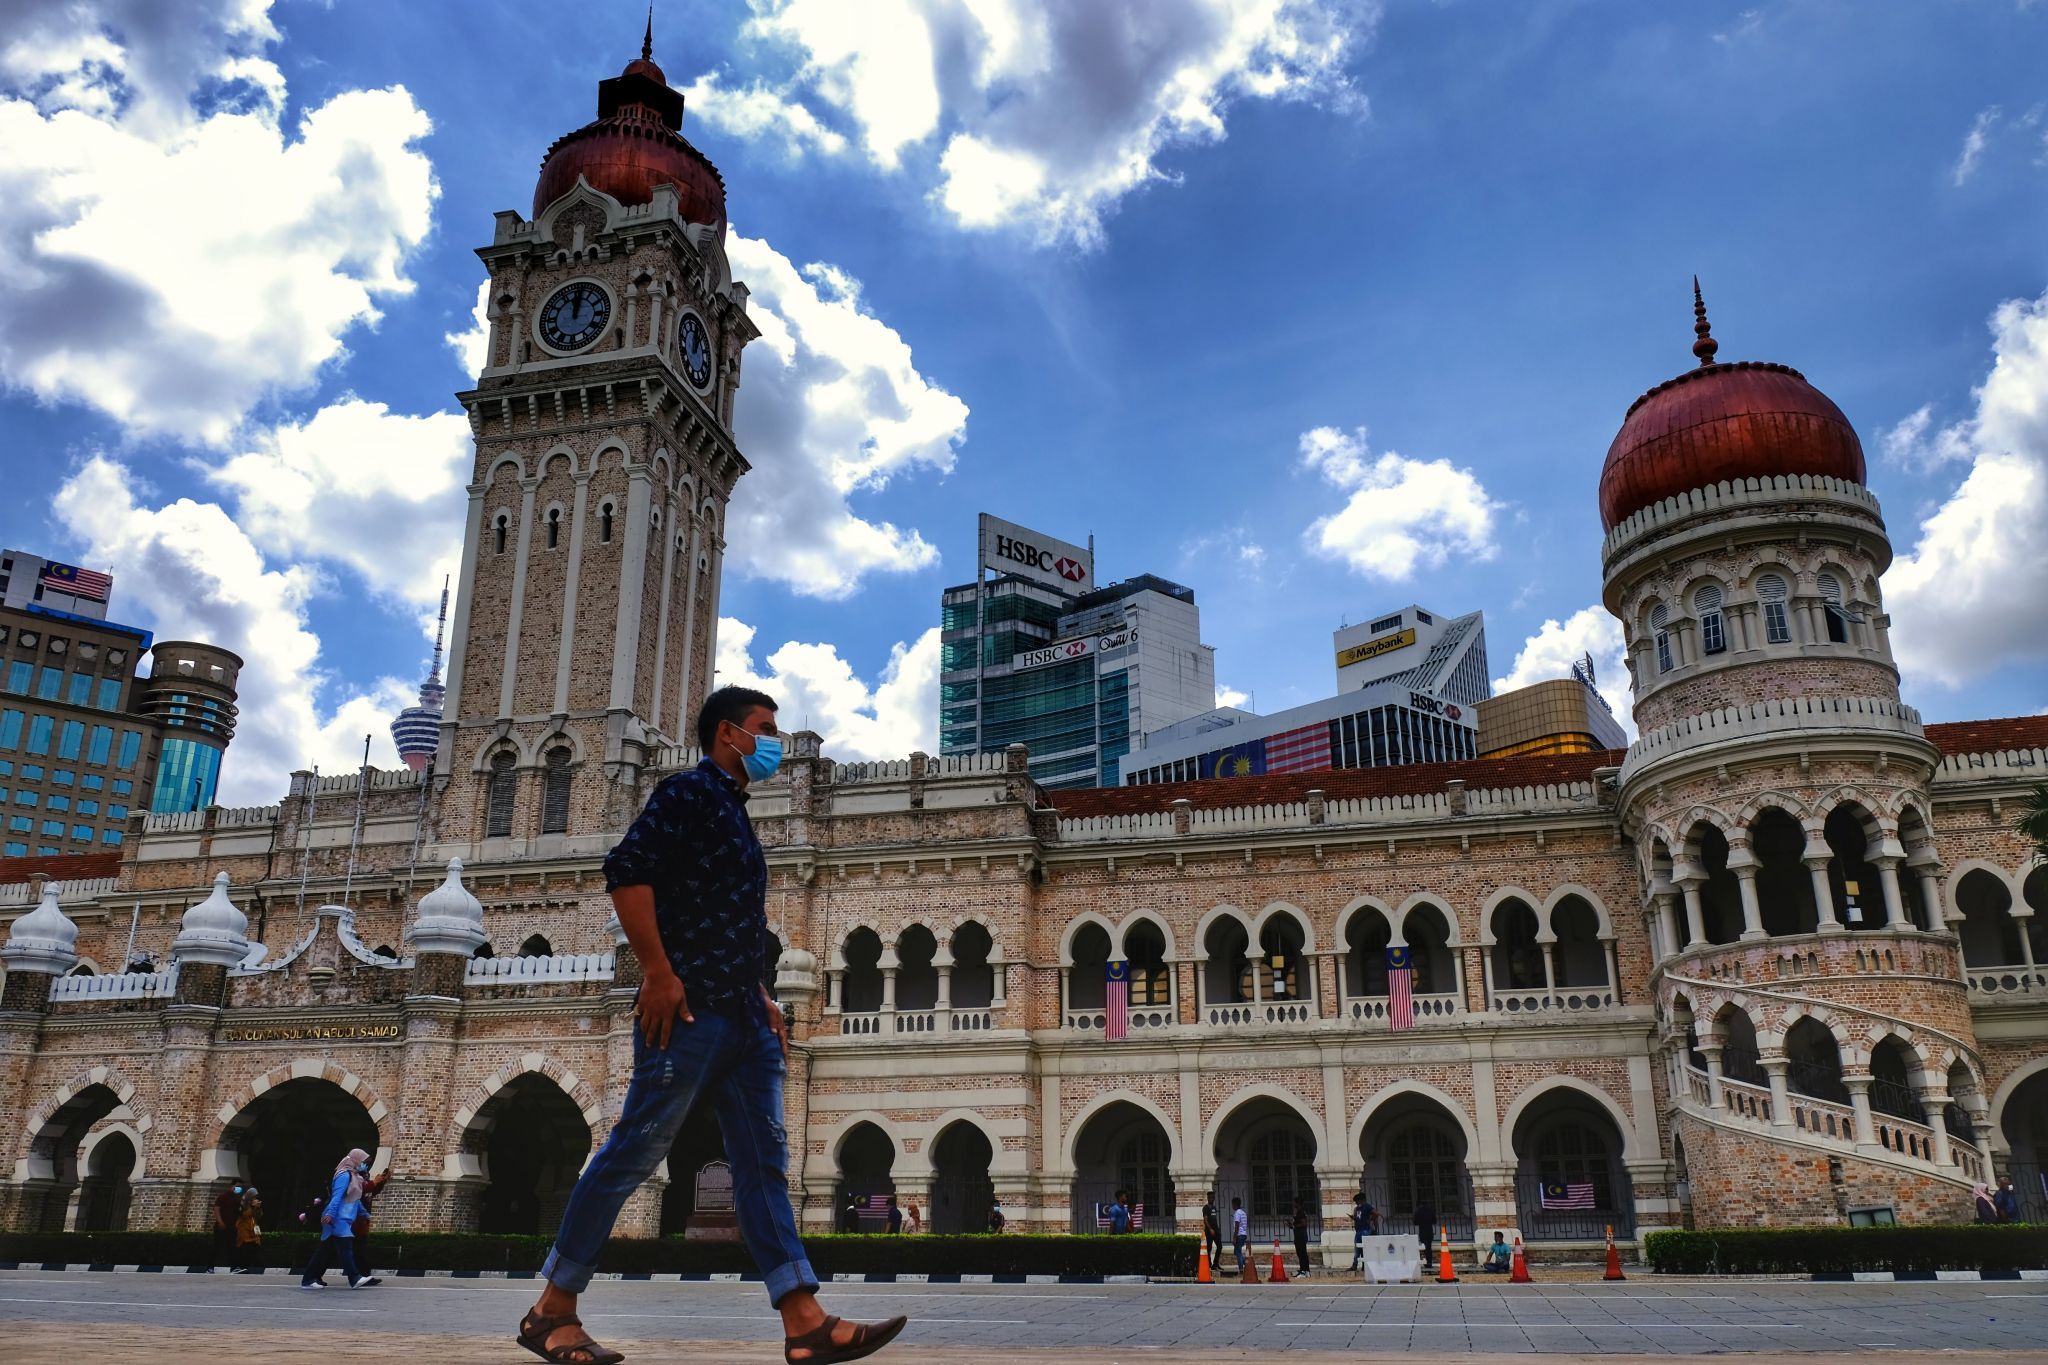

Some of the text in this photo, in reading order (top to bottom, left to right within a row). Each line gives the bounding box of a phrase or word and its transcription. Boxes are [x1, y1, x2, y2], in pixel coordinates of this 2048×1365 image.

[996, 534, 1053, 572] HSBC
[1130, 627, 1138, 642] 6
[1023, 646, 1063, 667] HSBC
[1356, 635, 1404, 658] Maybank
[1409, 691, 1445, 716] HSBC
[323, 1027, 356, 1038] ABDUL
[360, 1026, 398, 1037] SAMAD
